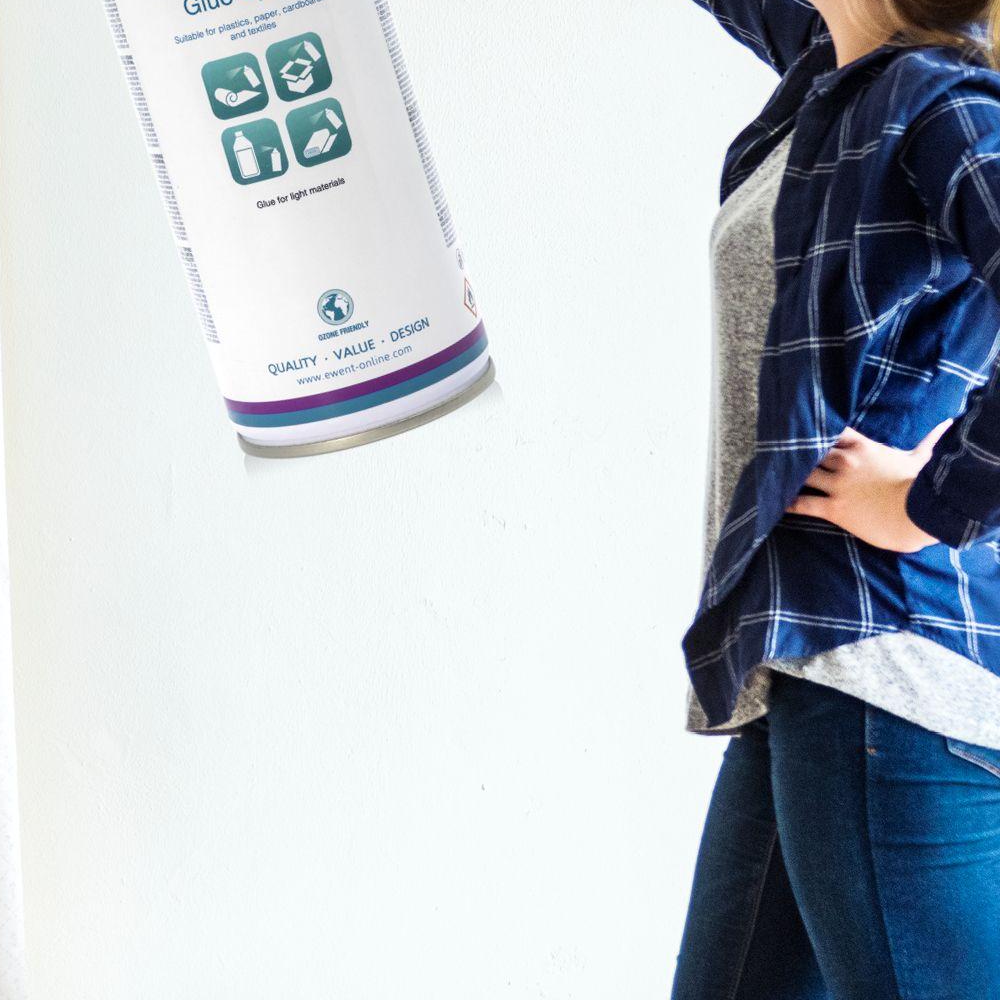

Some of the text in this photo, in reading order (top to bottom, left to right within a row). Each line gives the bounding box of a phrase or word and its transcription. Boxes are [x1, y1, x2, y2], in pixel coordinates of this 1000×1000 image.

[174, 29, 204, 45] Suitable
[205, 27, 217, 36] for
[218, 17, 253, 35] plastics,
[254, 9, 281, 24] paper,
[230, 20, 277, 41] and textiles
[256, 177, 346, 209] Glue for light materials
[268, 317, 430, 376] QUALITY VALUE DESIGN
[318, 320, 370, 342] OZONE FRIENDLY
[296, 343, 413, 386] www.ewent-online.com
